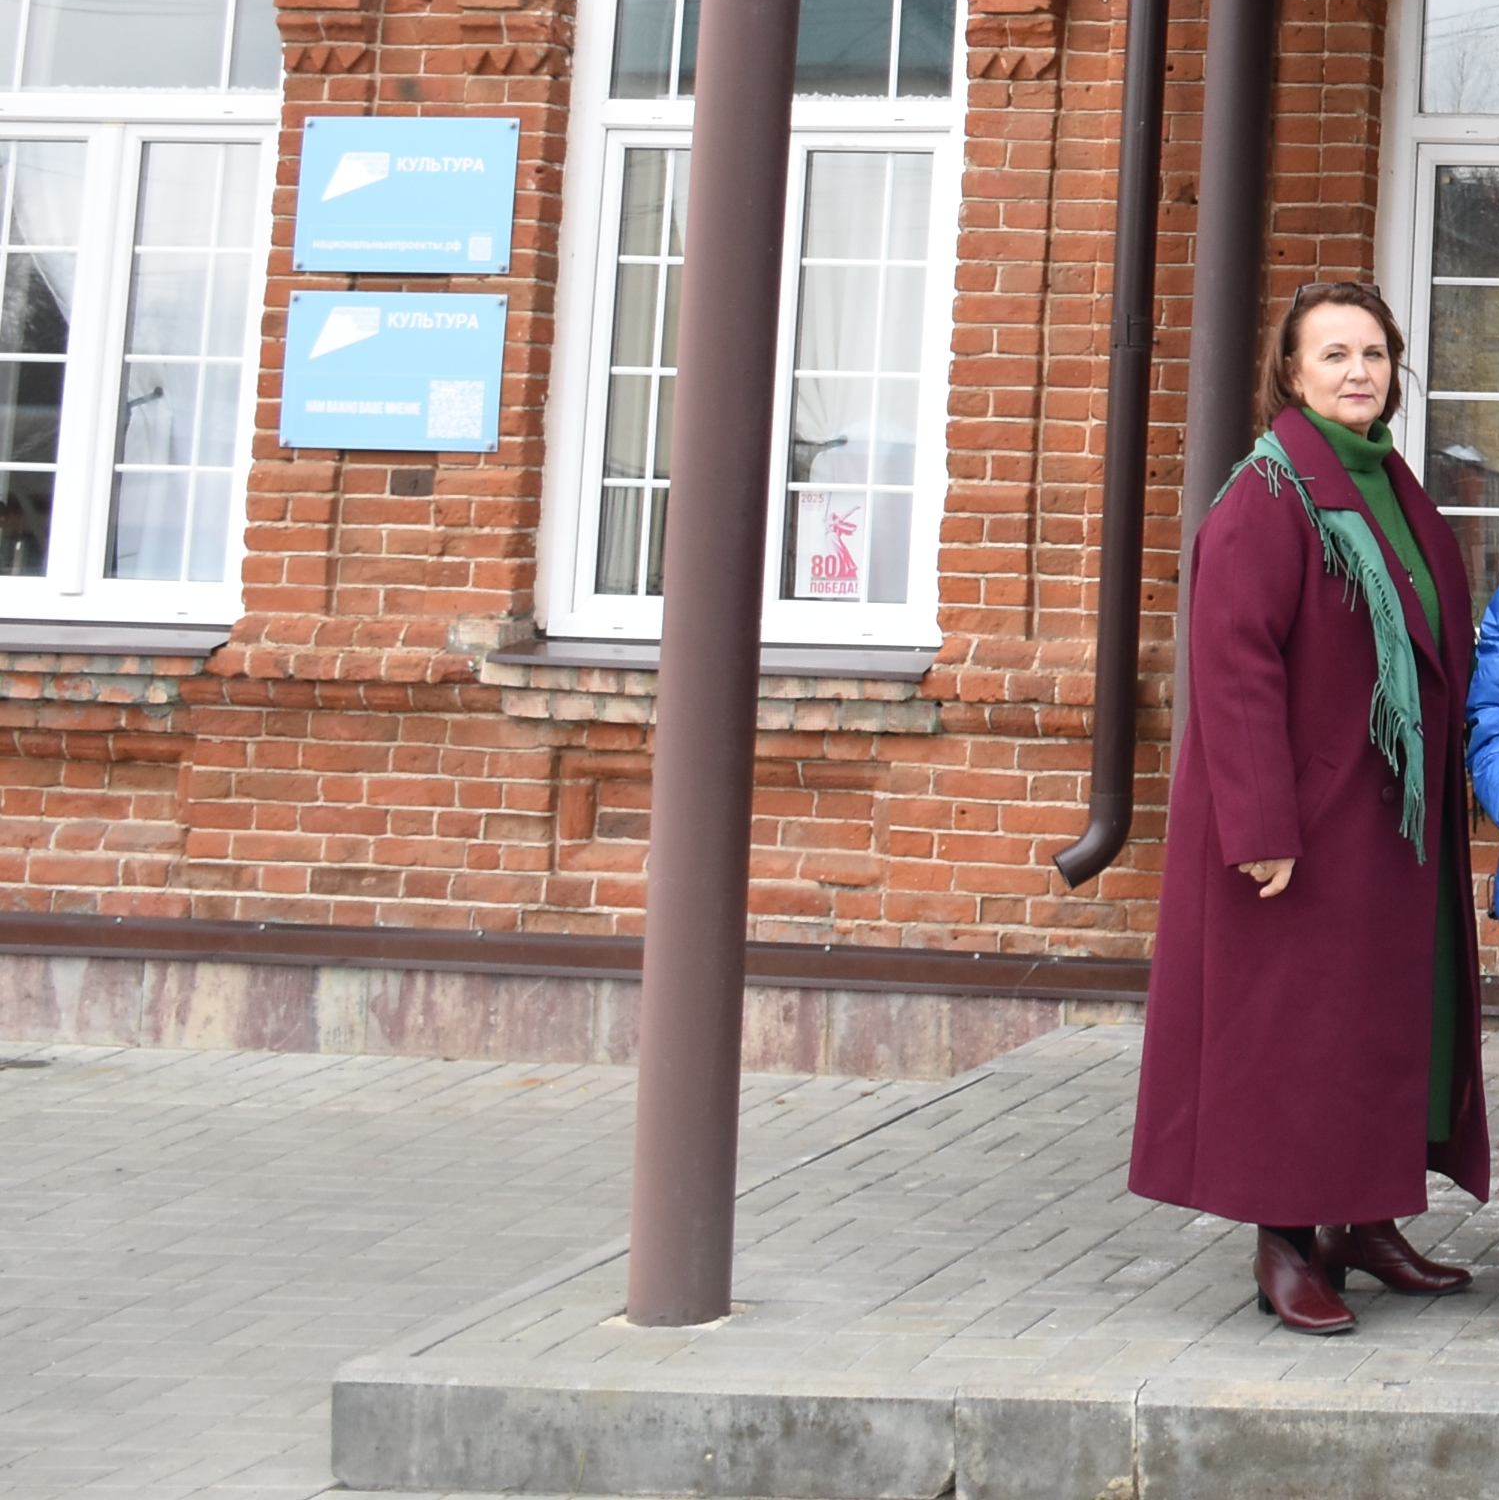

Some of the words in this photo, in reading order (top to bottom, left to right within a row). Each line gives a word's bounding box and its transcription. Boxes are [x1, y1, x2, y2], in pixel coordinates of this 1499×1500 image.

[397, 157, 485, 172] КУЛЬТУРА
[387, 312, 480, 329] КУЛЬТУРА
[801, 493, 824, 503] 2025
[811, 555, 837, 577] 80
[810, 582, 858, 594] ПОБЕДА!
